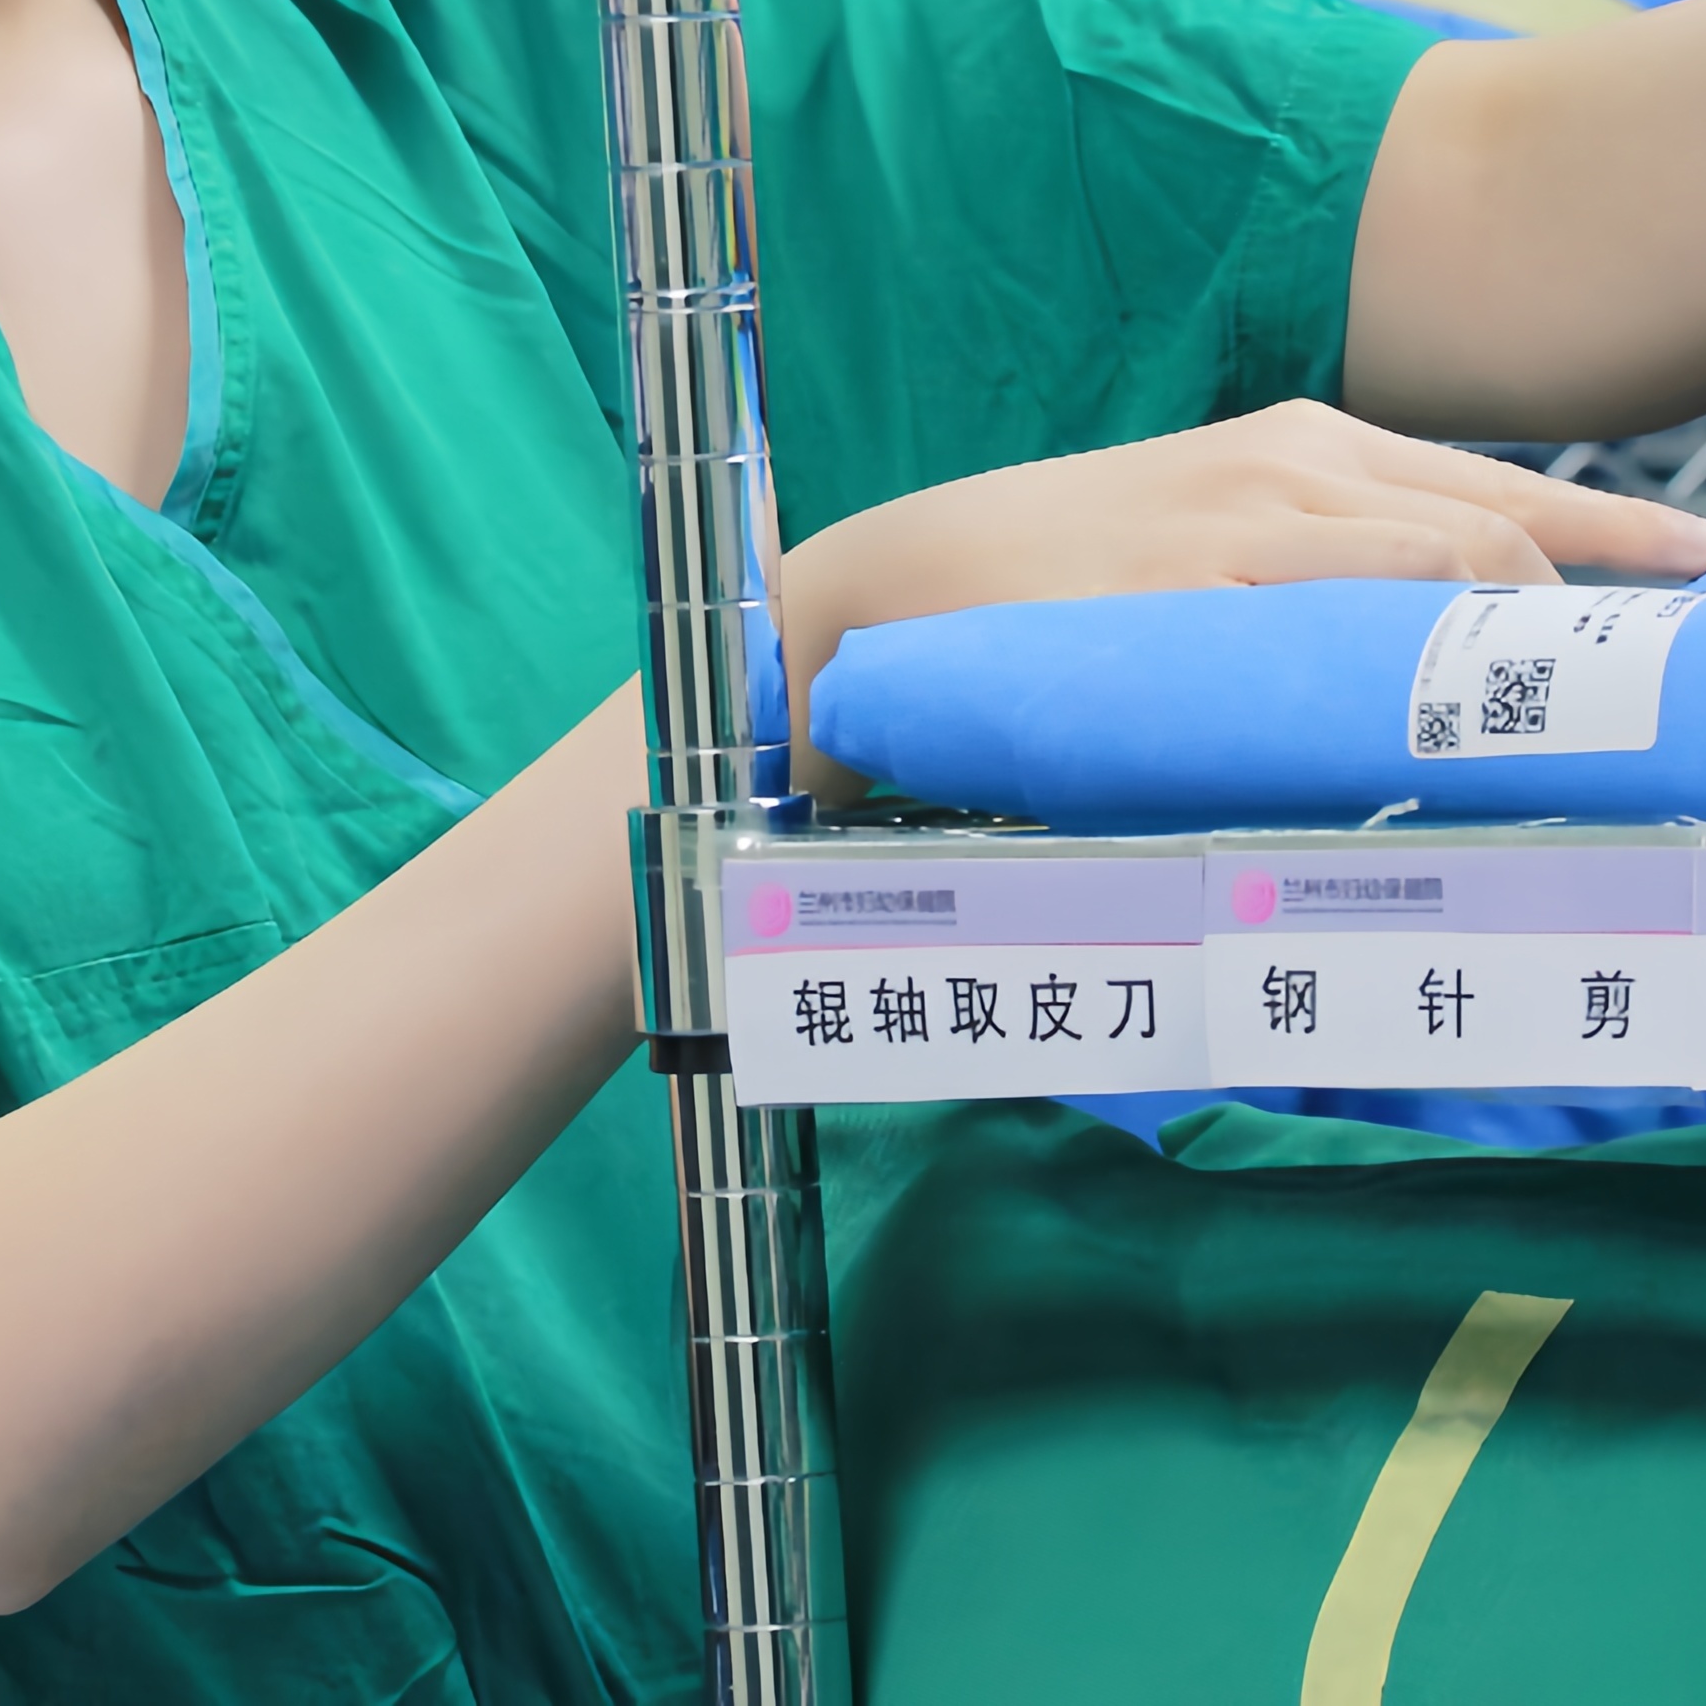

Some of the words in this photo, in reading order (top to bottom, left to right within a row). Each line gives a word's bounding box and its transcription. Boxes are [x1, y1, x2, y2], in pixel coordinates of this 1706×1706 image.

[792, 973, 1157, 1046] 辊轴取皮刀
[1261, 965, 1636, 1039] 钢针剪
